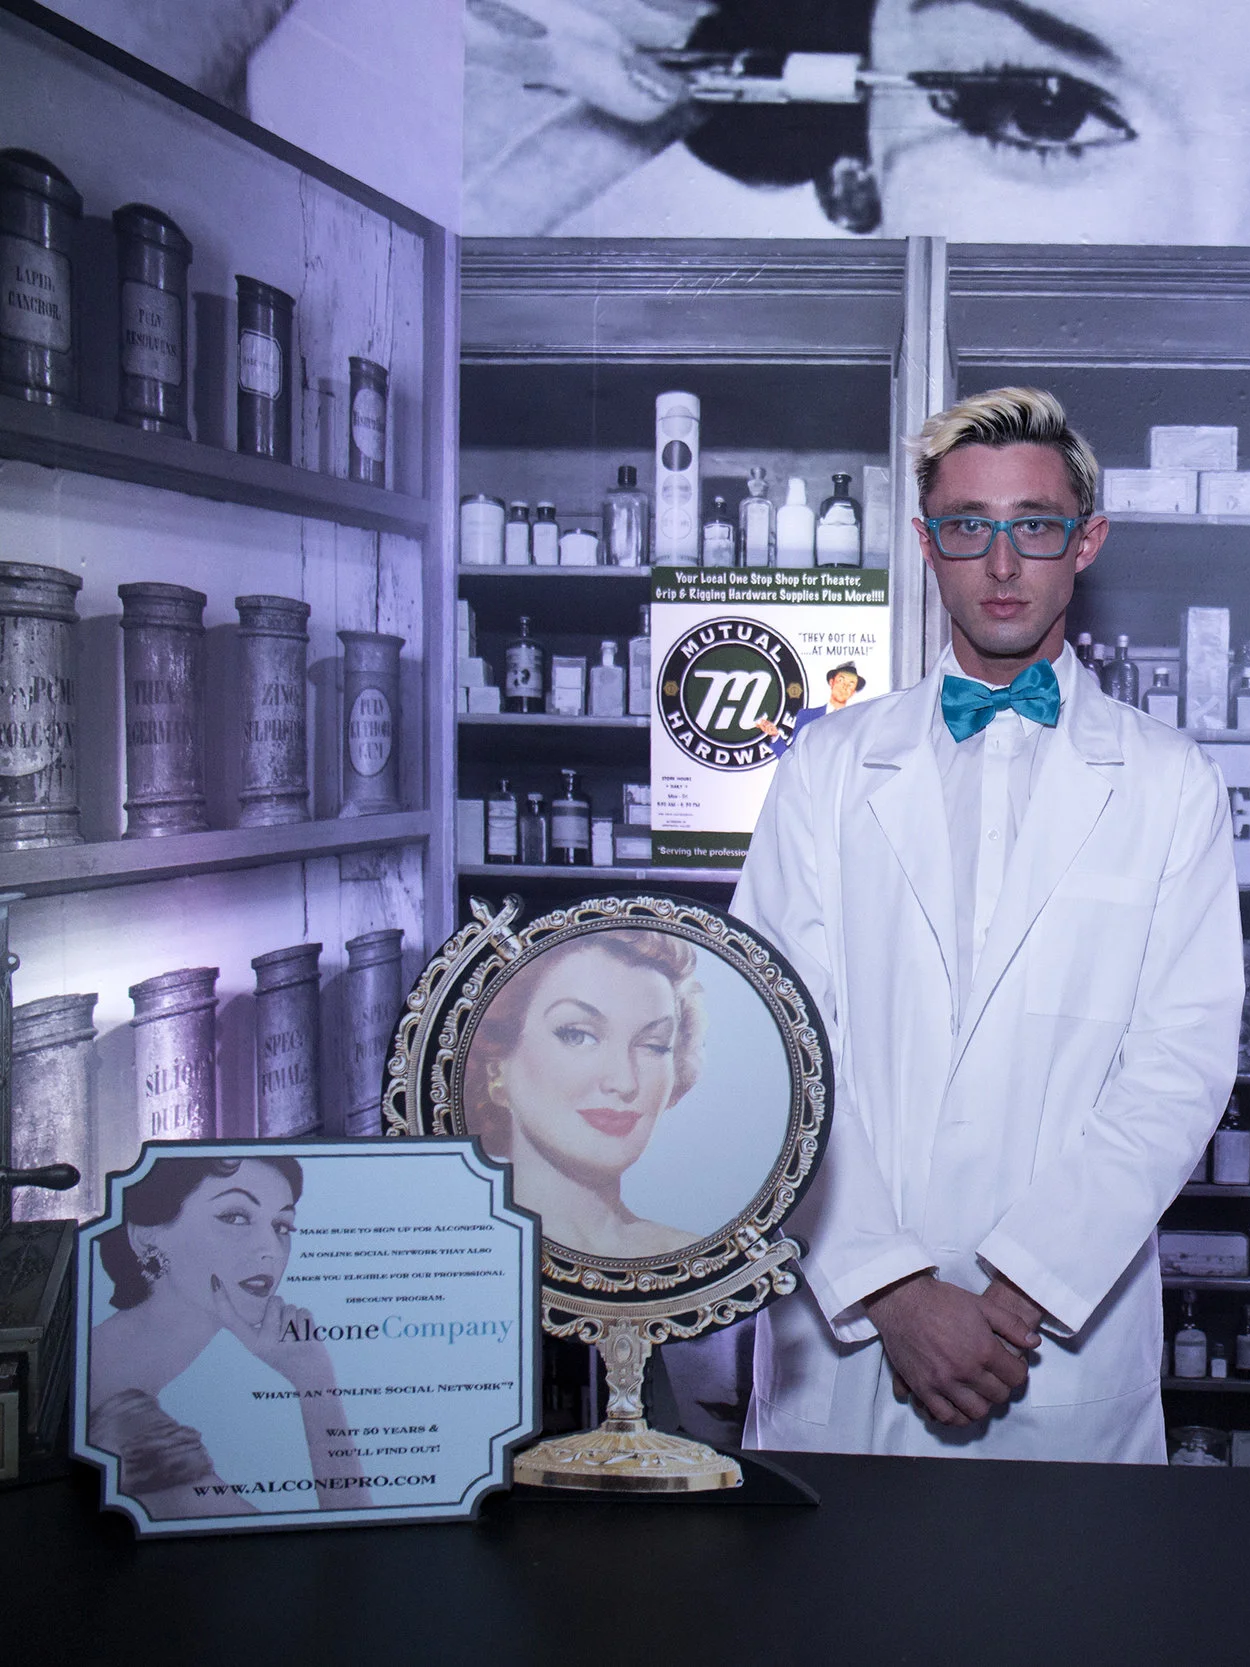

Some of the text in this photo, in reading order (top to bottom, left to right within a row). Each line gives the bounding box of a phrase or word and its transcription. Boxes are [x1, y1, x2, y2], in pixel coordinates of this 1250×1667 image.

[675, 572, 862, 588] Your Local One Stop Shop for Theater,
[655, 588, 677, 602] Grip
[679, 588, 687, 600] &
[689, 588, 726, 603] Rigging
[728, 588, 778, 601] Hardware
[779, 589, 820, 603] Supplies
[822, 590, 842, 602] Plus
[680, 624, 784, 663] MUTUAL
[828, 633, 846, 643] GOT
[848, 633, 856, 643] IT
[860, 633, 877, 643] ALL
[694, 848, 708, 857] the
[709, 848, 750, 857] professio
[304, 1390, 322, 1398] AN
[385, 1385, 434, 1395] SOCIAL
[326, 1424, 439, 1437] WAIT 50 YEARS &
[376, 1446, 408, 1456] FIND
[193, 1474, 436, 1497] WWW.ALCONEPRO.COM
